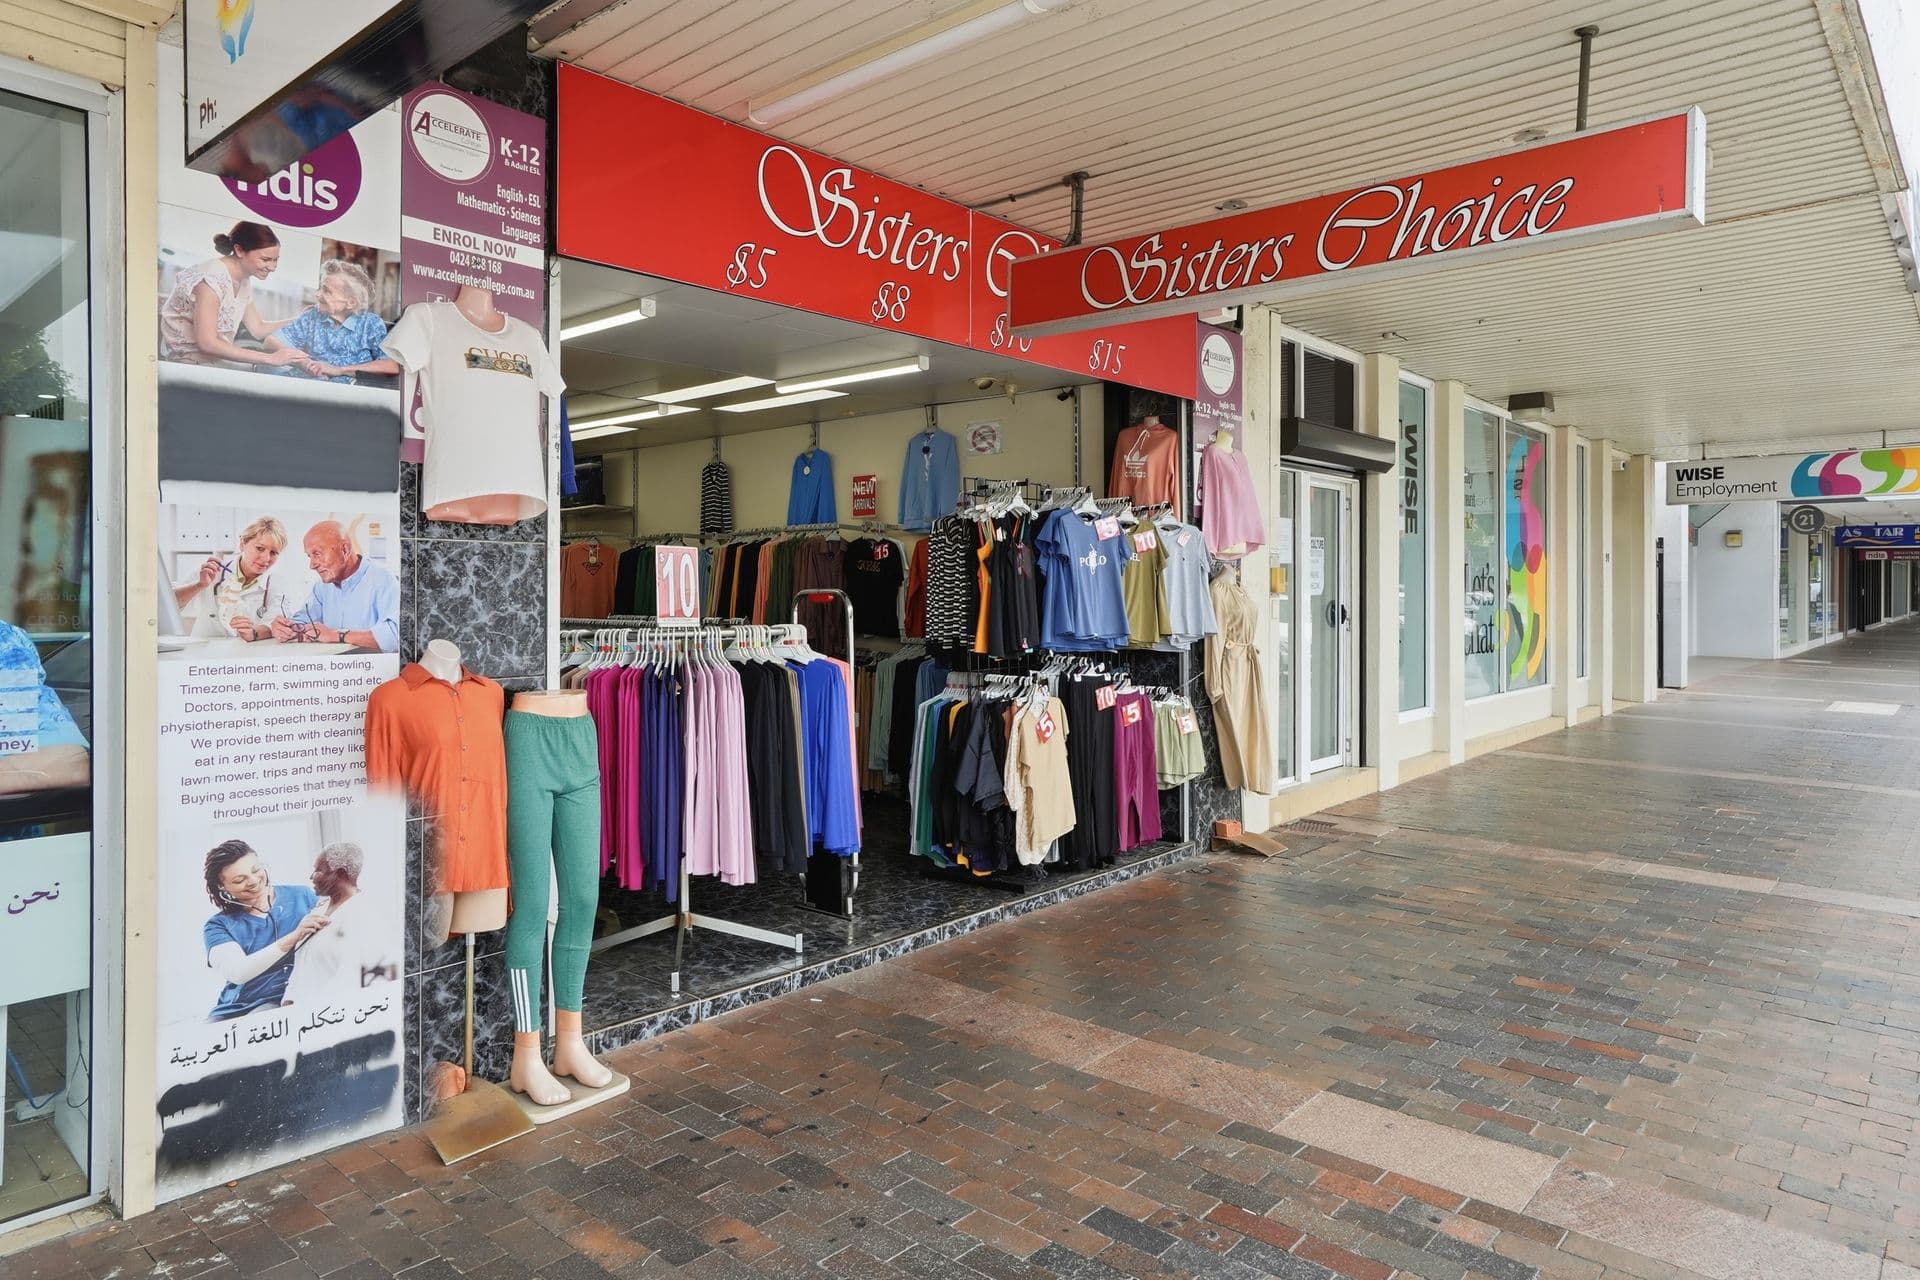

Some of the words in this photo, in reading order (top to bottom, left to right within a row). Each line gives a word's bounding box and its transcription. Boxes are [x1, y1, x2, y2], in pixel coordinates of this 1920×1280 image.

[413, 111, 482, 141] ACCELERATE
[500, 137, 540, 166] K-12
[510, 160, 529, 173] Adult
[529, 164, 541, 175] ESL
[496, 184, 524, 203] English
[528, 193, 541, 208] ESL
[456, 191, 506, 216] Mathematics
[510, 206, 541, 226] Sciences
[757, 145, 969, 281] Sisters
[433, 227, 480, 250] ENROL
[483, 241, 517, 259] NOW
[501, 222, 541, 244] Languages
[1080, 232, 1295, 310] Sisters
[1316, 176, 1575, 271] Choice
[449, 250, 470, 267] 0424
[487, 259, 502, 275] 168
[412, 264, 535, 299] www.acceleratecollege.com.au
[726, 243, 777, 289] $5
[871, 281, 911, 322] $8
[1088, 339, 1127, 374] $15
[1405, 424, 1418, 534] WISE
[1675, 466, 1725, 482] WISE
[853, 480, 875, 495] NEW
[1675, 480, 1778, 498] Employment
[1080, 555, 1107, 567] POO
[188, 663, 278, 676] Entertainment:
[282, 662, 327, 673] cinema,
[179, 683, 245, 695] Timezone,
[249, 681, 279, 691] farm,
[283, 677, 339, 689] swimming
[342, 676, 363, 686] and
[184, 702, 237, 713] Doctors,
[241, 696, 323, 711] appointments,
[160, 717, 260, 735] physiotherapist,
[263, 713, 306, 727] speech
[309, 711, 352, 723] therapy
[354, 711, 367, 719] an
[190, 738, 212, 749] We
[216, 734, 262, 749] provide
[265, 733, 294, 743] them
[297, 730, 321, 740] with
[194, 756, 214, 767] eat
[218, 755, 229, 765] in
[233, 754, 256, 764] any
[259, 747, 318, 761] restaurant
[321, 745, 345, 756] they
[181, 776, 211, 787] lawn
[263, 768, 288, 779] trips
[291, 764, 313, 775] and
[316, 762, 347, 773] many
[349, 760, 367, 769] mo
[181, 791, 225, 806] Buying
[229, 785, 300, 800] accessories
[303, 781, 325, 792] that
[327, 779, 351, 789] they
[213, 803, 279, 819] throughout
[283, 800, 309, 811] their
[311, 795, 354, 810] journey.
[8, 882, 61, 915] نحن
[353, 997, 390, 1024] نحن
